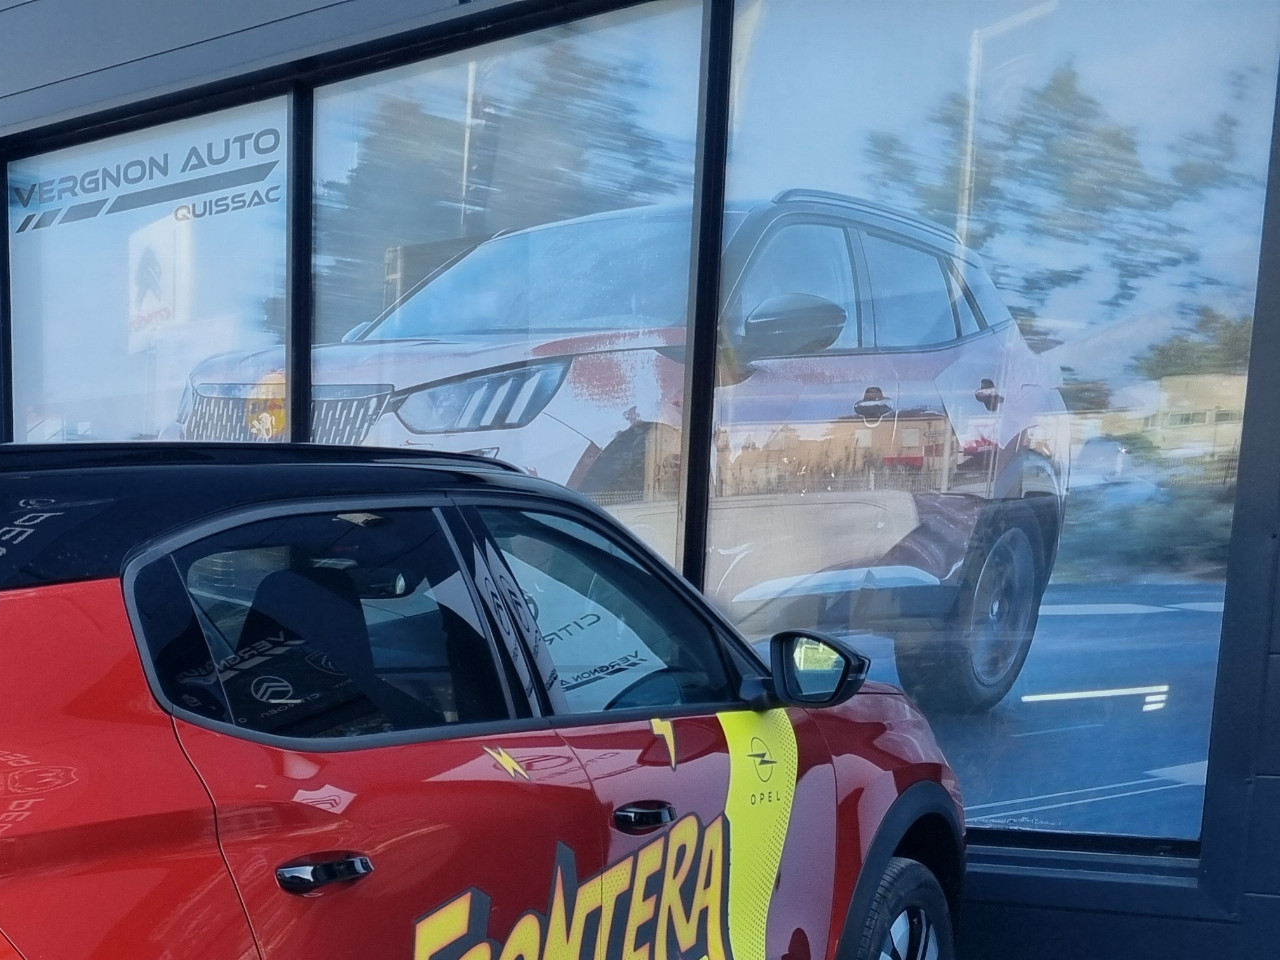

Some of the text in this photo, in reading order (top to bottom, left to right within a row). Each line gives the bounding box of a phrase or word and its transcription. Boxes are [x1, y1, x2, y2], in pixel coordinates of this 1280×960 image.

[14, 128, 281, 209] VERGNON AUTO
[173, 185, 281, 222] QUISSAC
[750, 790, 781, 806] OPEL
